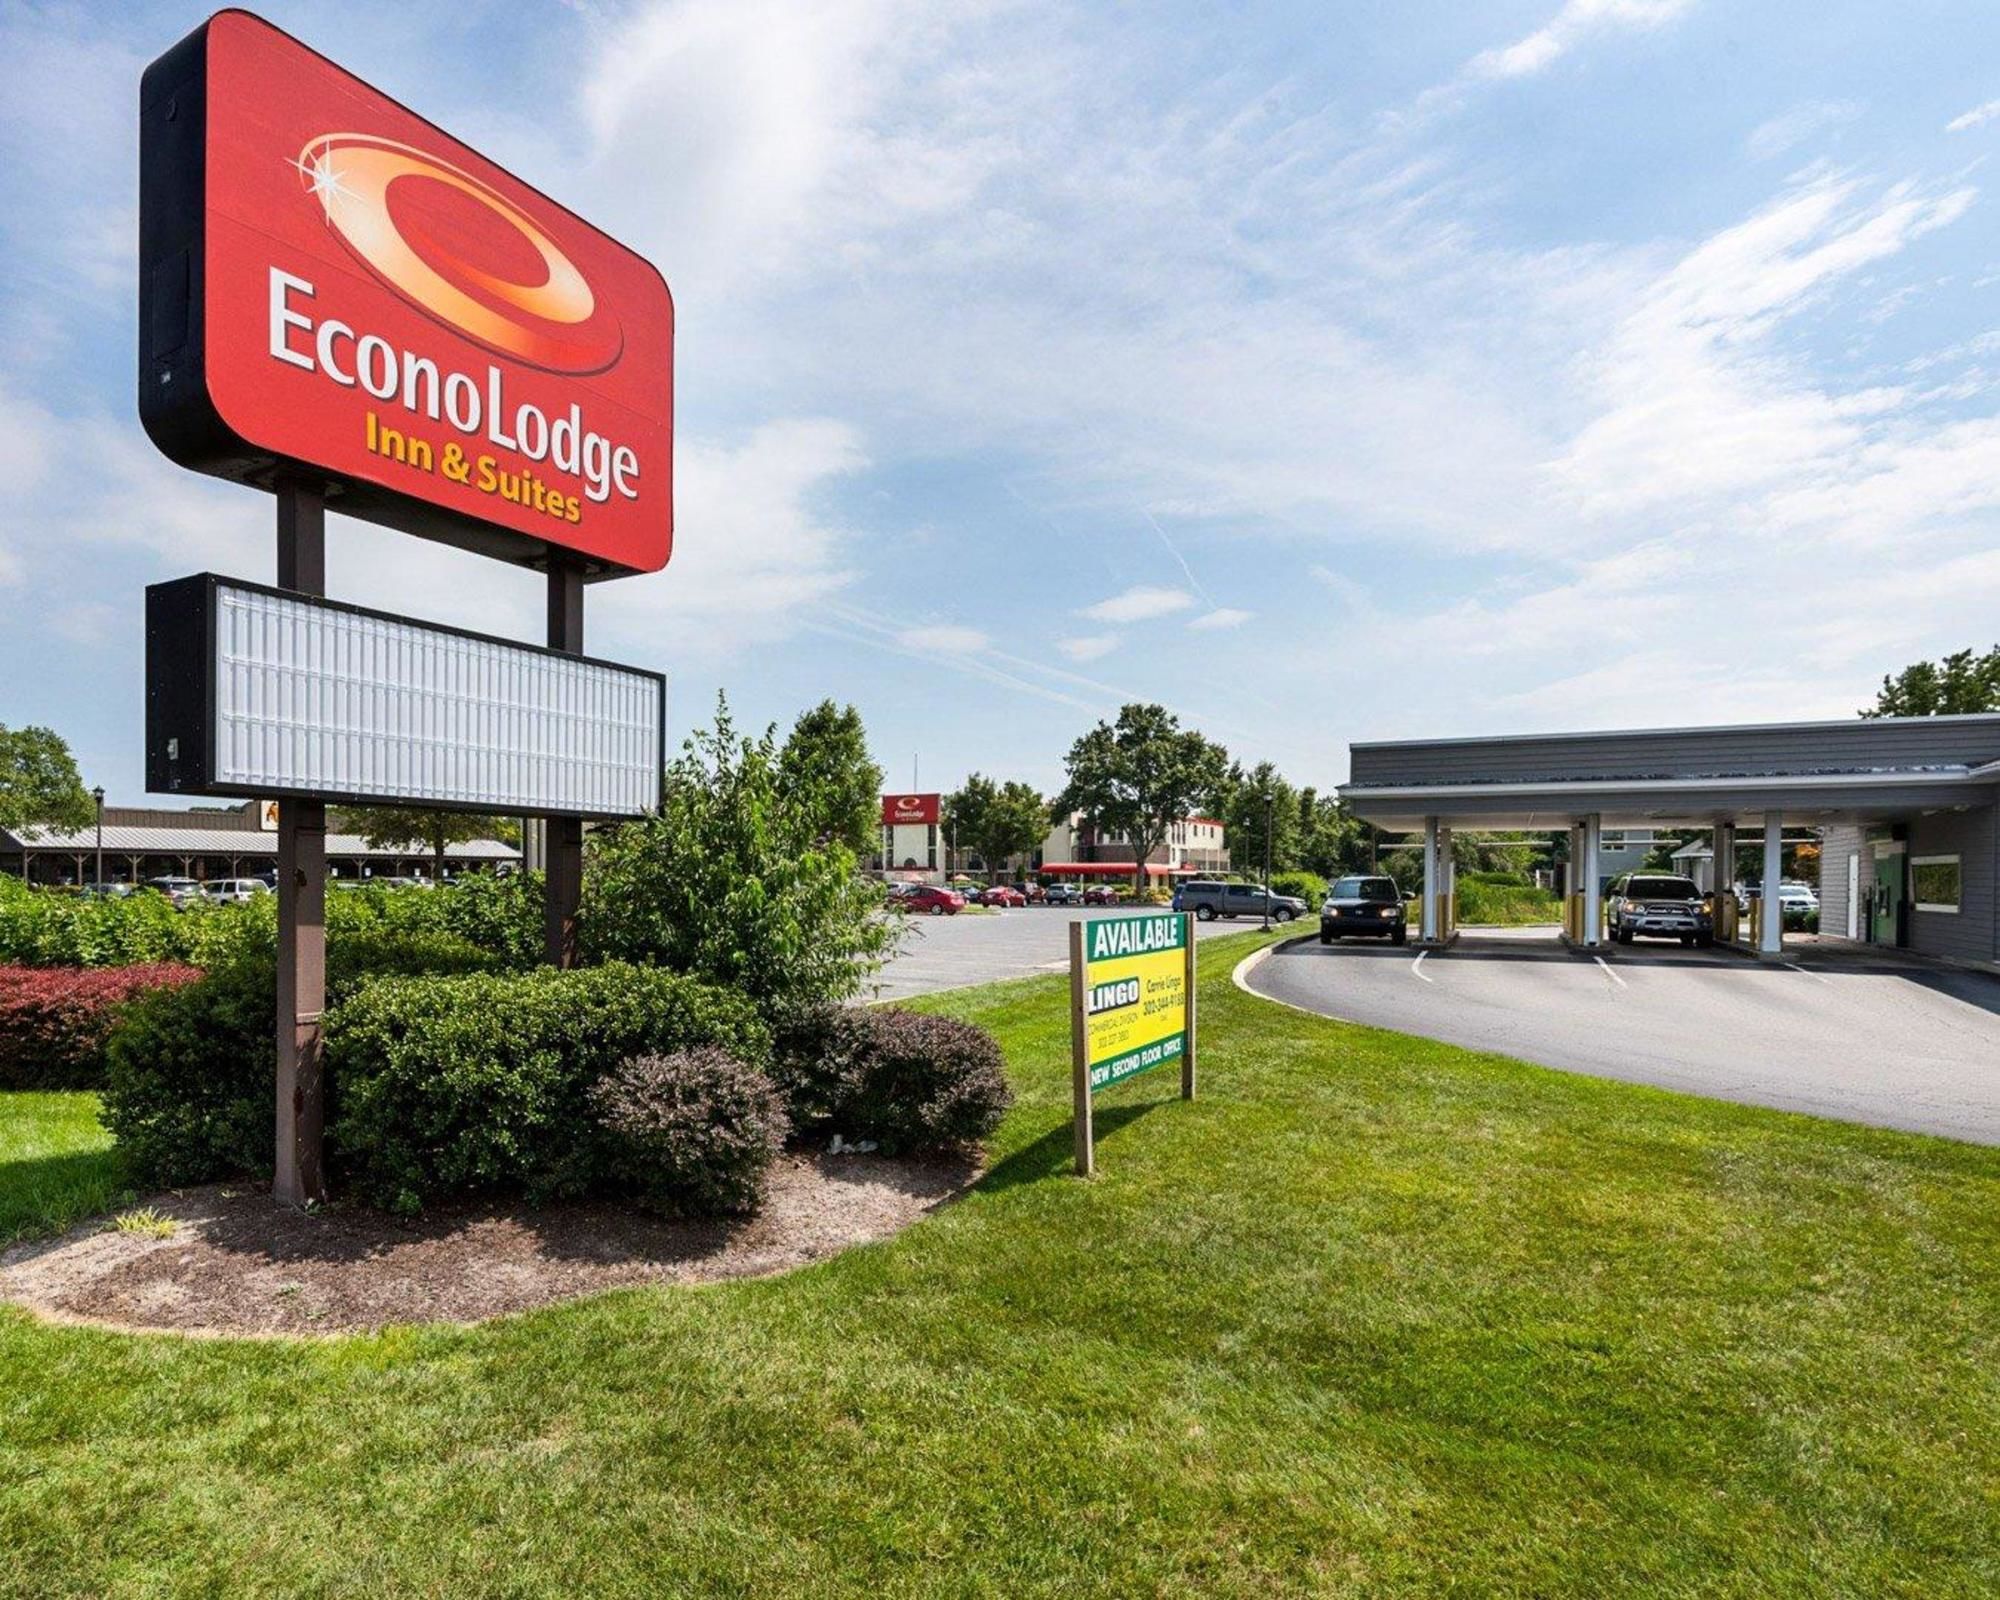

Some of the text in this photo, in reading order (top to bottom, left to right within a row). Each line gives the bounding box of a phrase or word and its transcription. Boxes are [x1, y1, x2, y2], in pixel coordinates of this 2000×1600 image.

[269, 266, 639, 502] EconoLodge
[365, 411, 581, 523] Inn & Suites
[1094, 917, 1178, 958] AVAILABLE
[1088, 980, 1138, 1012] LINGO
[1091, 1038, 1181, 1087] NEW SECOND FLOOR OFFICE
